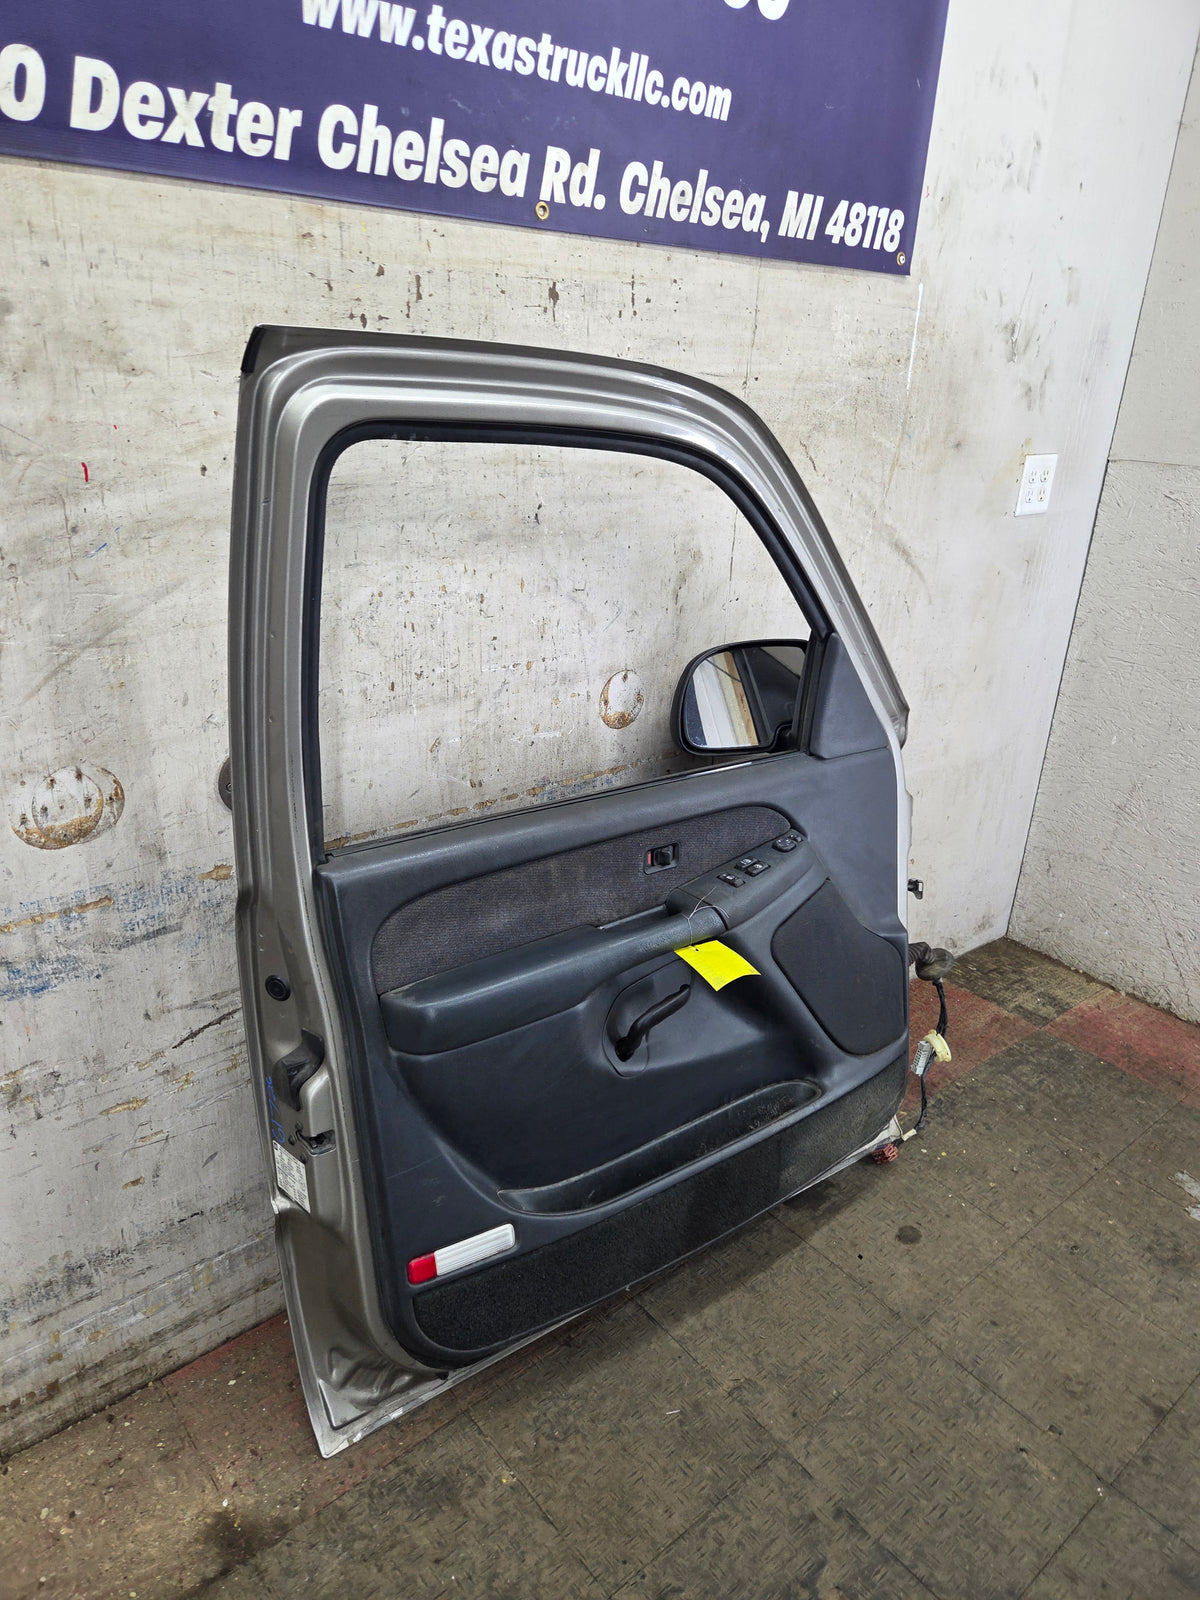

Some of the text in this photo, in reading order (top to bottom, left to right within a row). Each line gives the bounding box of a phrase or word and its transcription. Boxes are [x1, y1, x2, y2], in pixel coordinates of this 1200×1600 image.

[302, 0, 733, 122] www.texastruckllc.com
[69, 55, 303, 161] Dexter
[317, 103, 531, 198] Chelsea
[538, 145, 606, 211] Rd.
[619, 159, 771, 243] Chelsea,
[777, 190, 825, 241] MI
[824, 199, 905, 253] 48118
